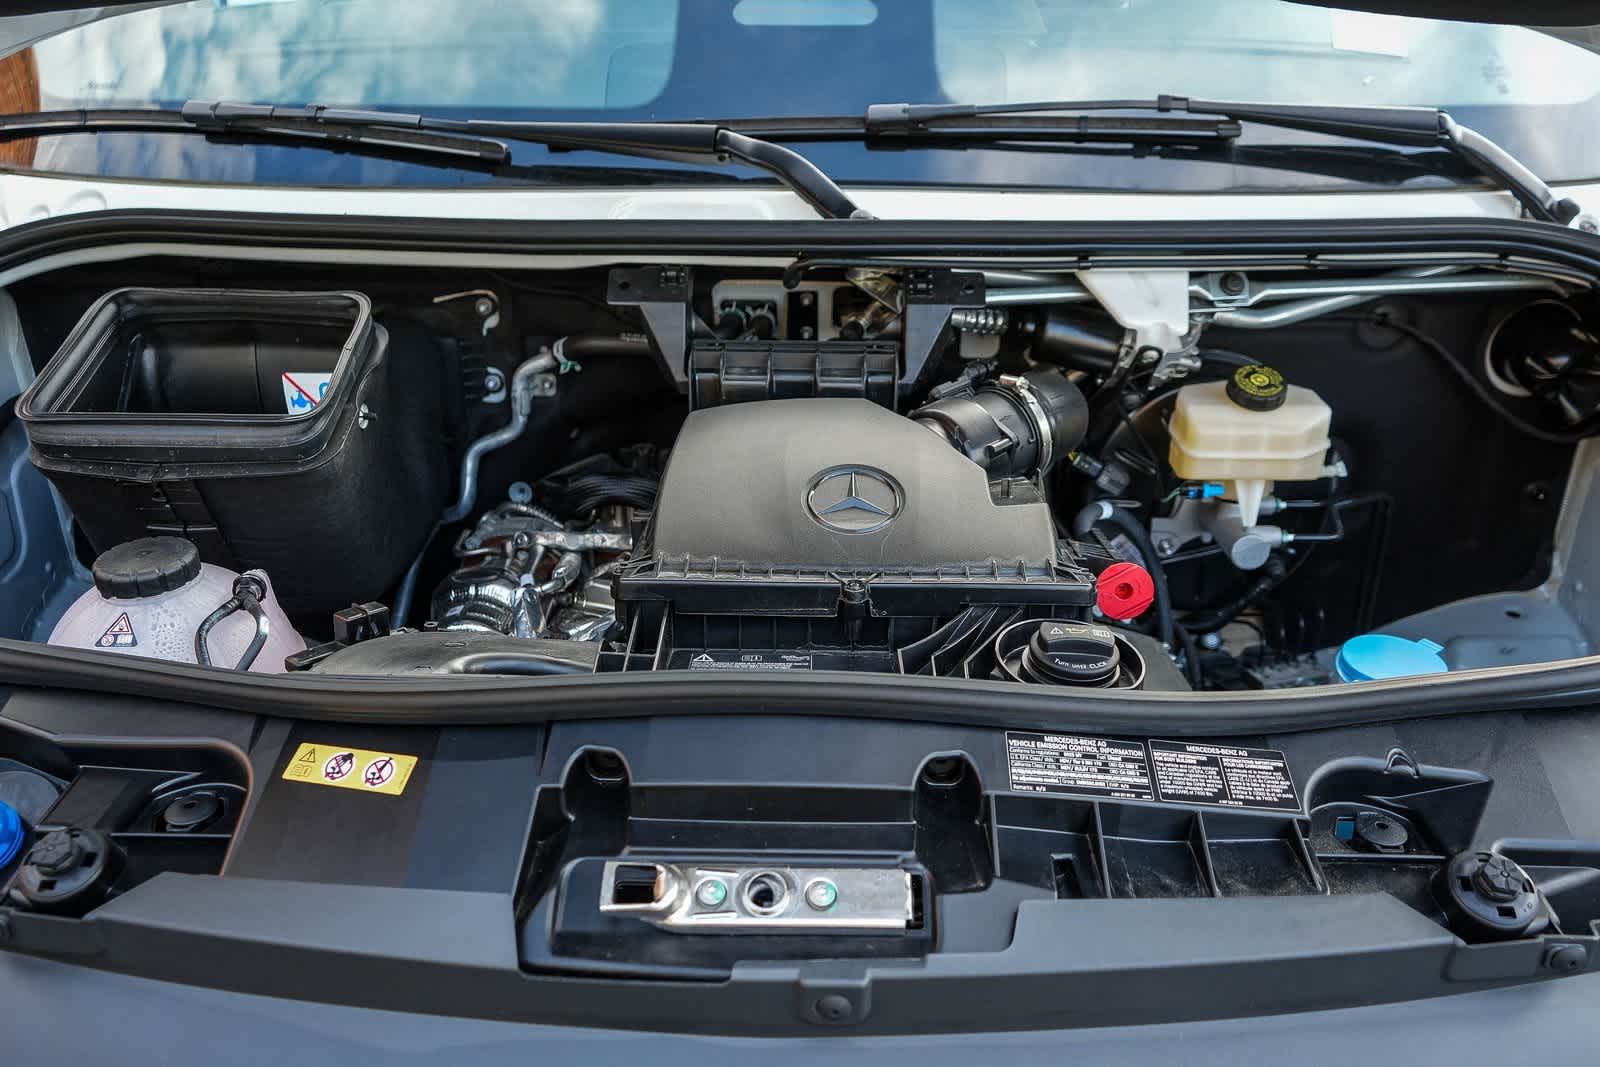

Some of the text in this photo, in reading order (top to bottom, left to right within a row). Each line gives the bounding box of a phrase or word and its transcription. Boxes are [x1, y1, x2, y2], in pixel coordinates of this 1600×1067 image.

[1054, 657, 1069, 668] Turn
[1044, 736, 1096, 747] MERCEDES-BENZ
[1008, 739, 1144, 756] VEHICLE EMISSION CONTROL INFORMATION
[1186, 744, 1238, 756] MERCEDES-BENZ
